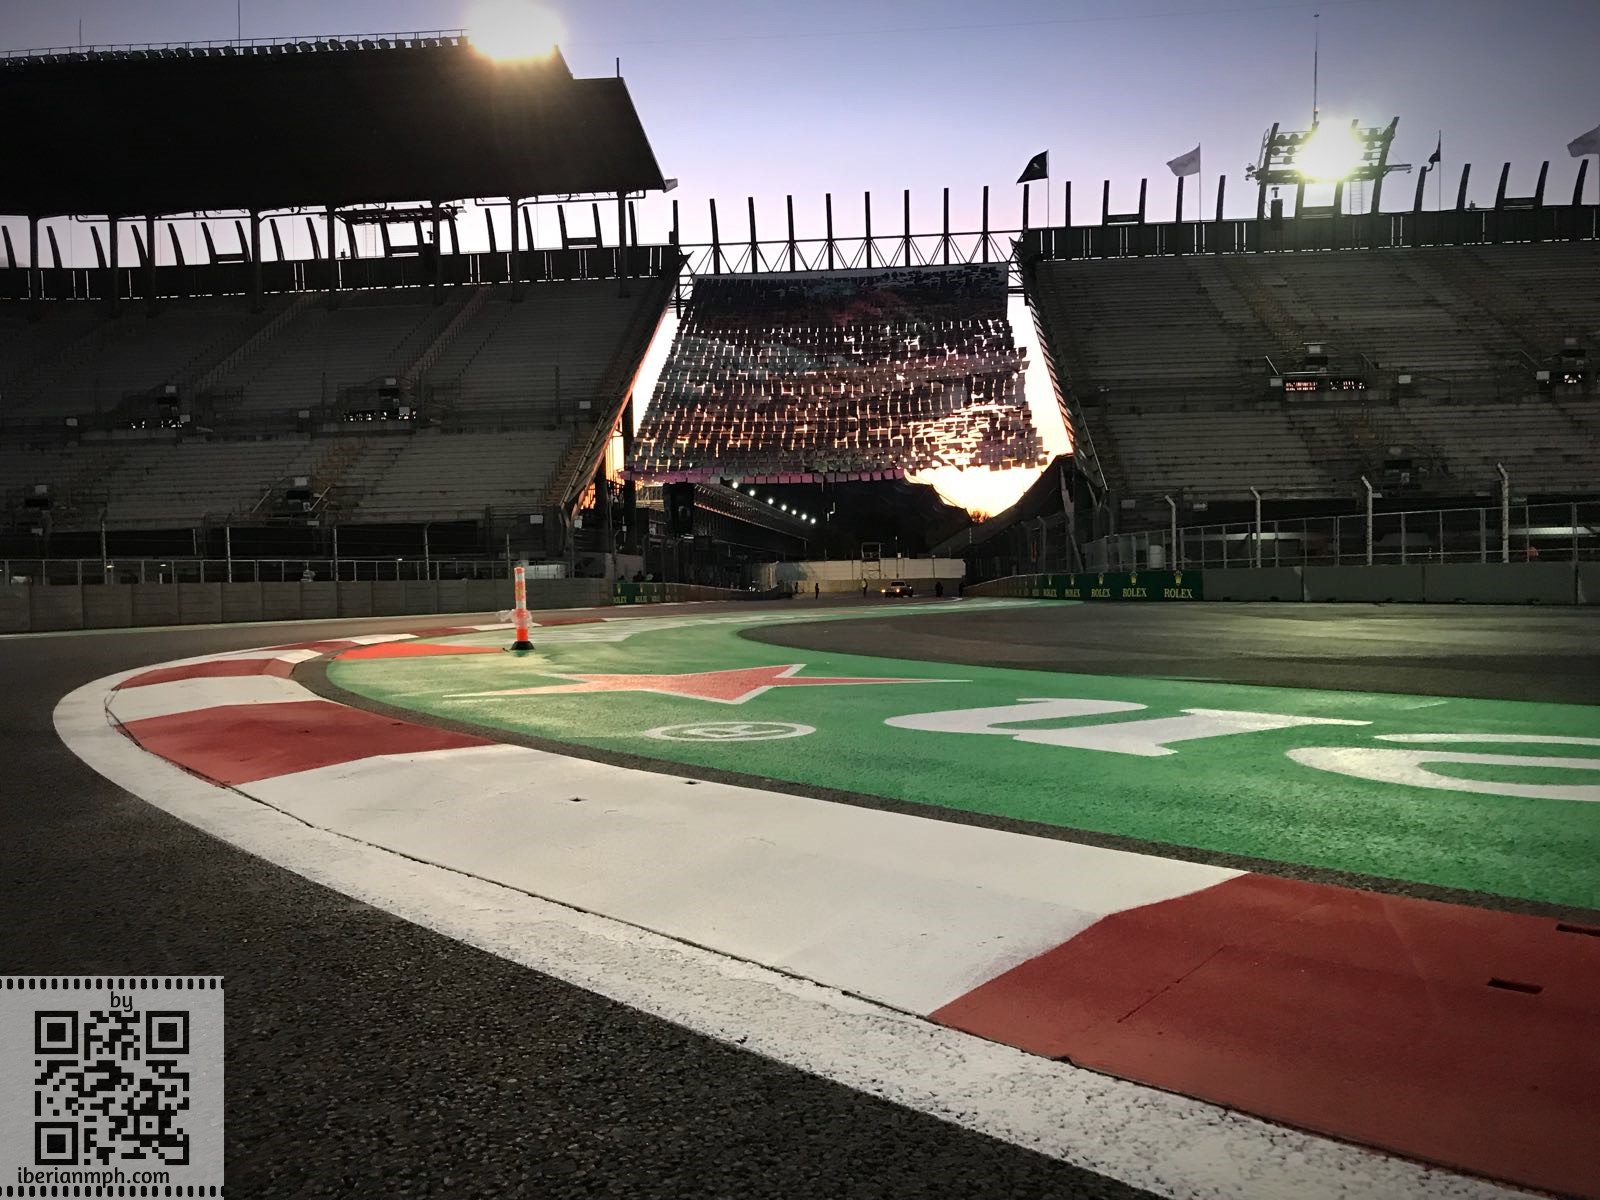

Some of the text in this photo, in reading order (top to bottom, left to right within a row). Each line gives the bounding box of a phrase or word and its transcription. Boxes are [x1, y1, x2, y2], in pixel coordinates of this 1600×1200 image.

[1091, 588, 1111, 598] ROLEX
[1122, 587, 1147, 598] ROLEX
[1164, 588, 1193, 599] ROLEX
